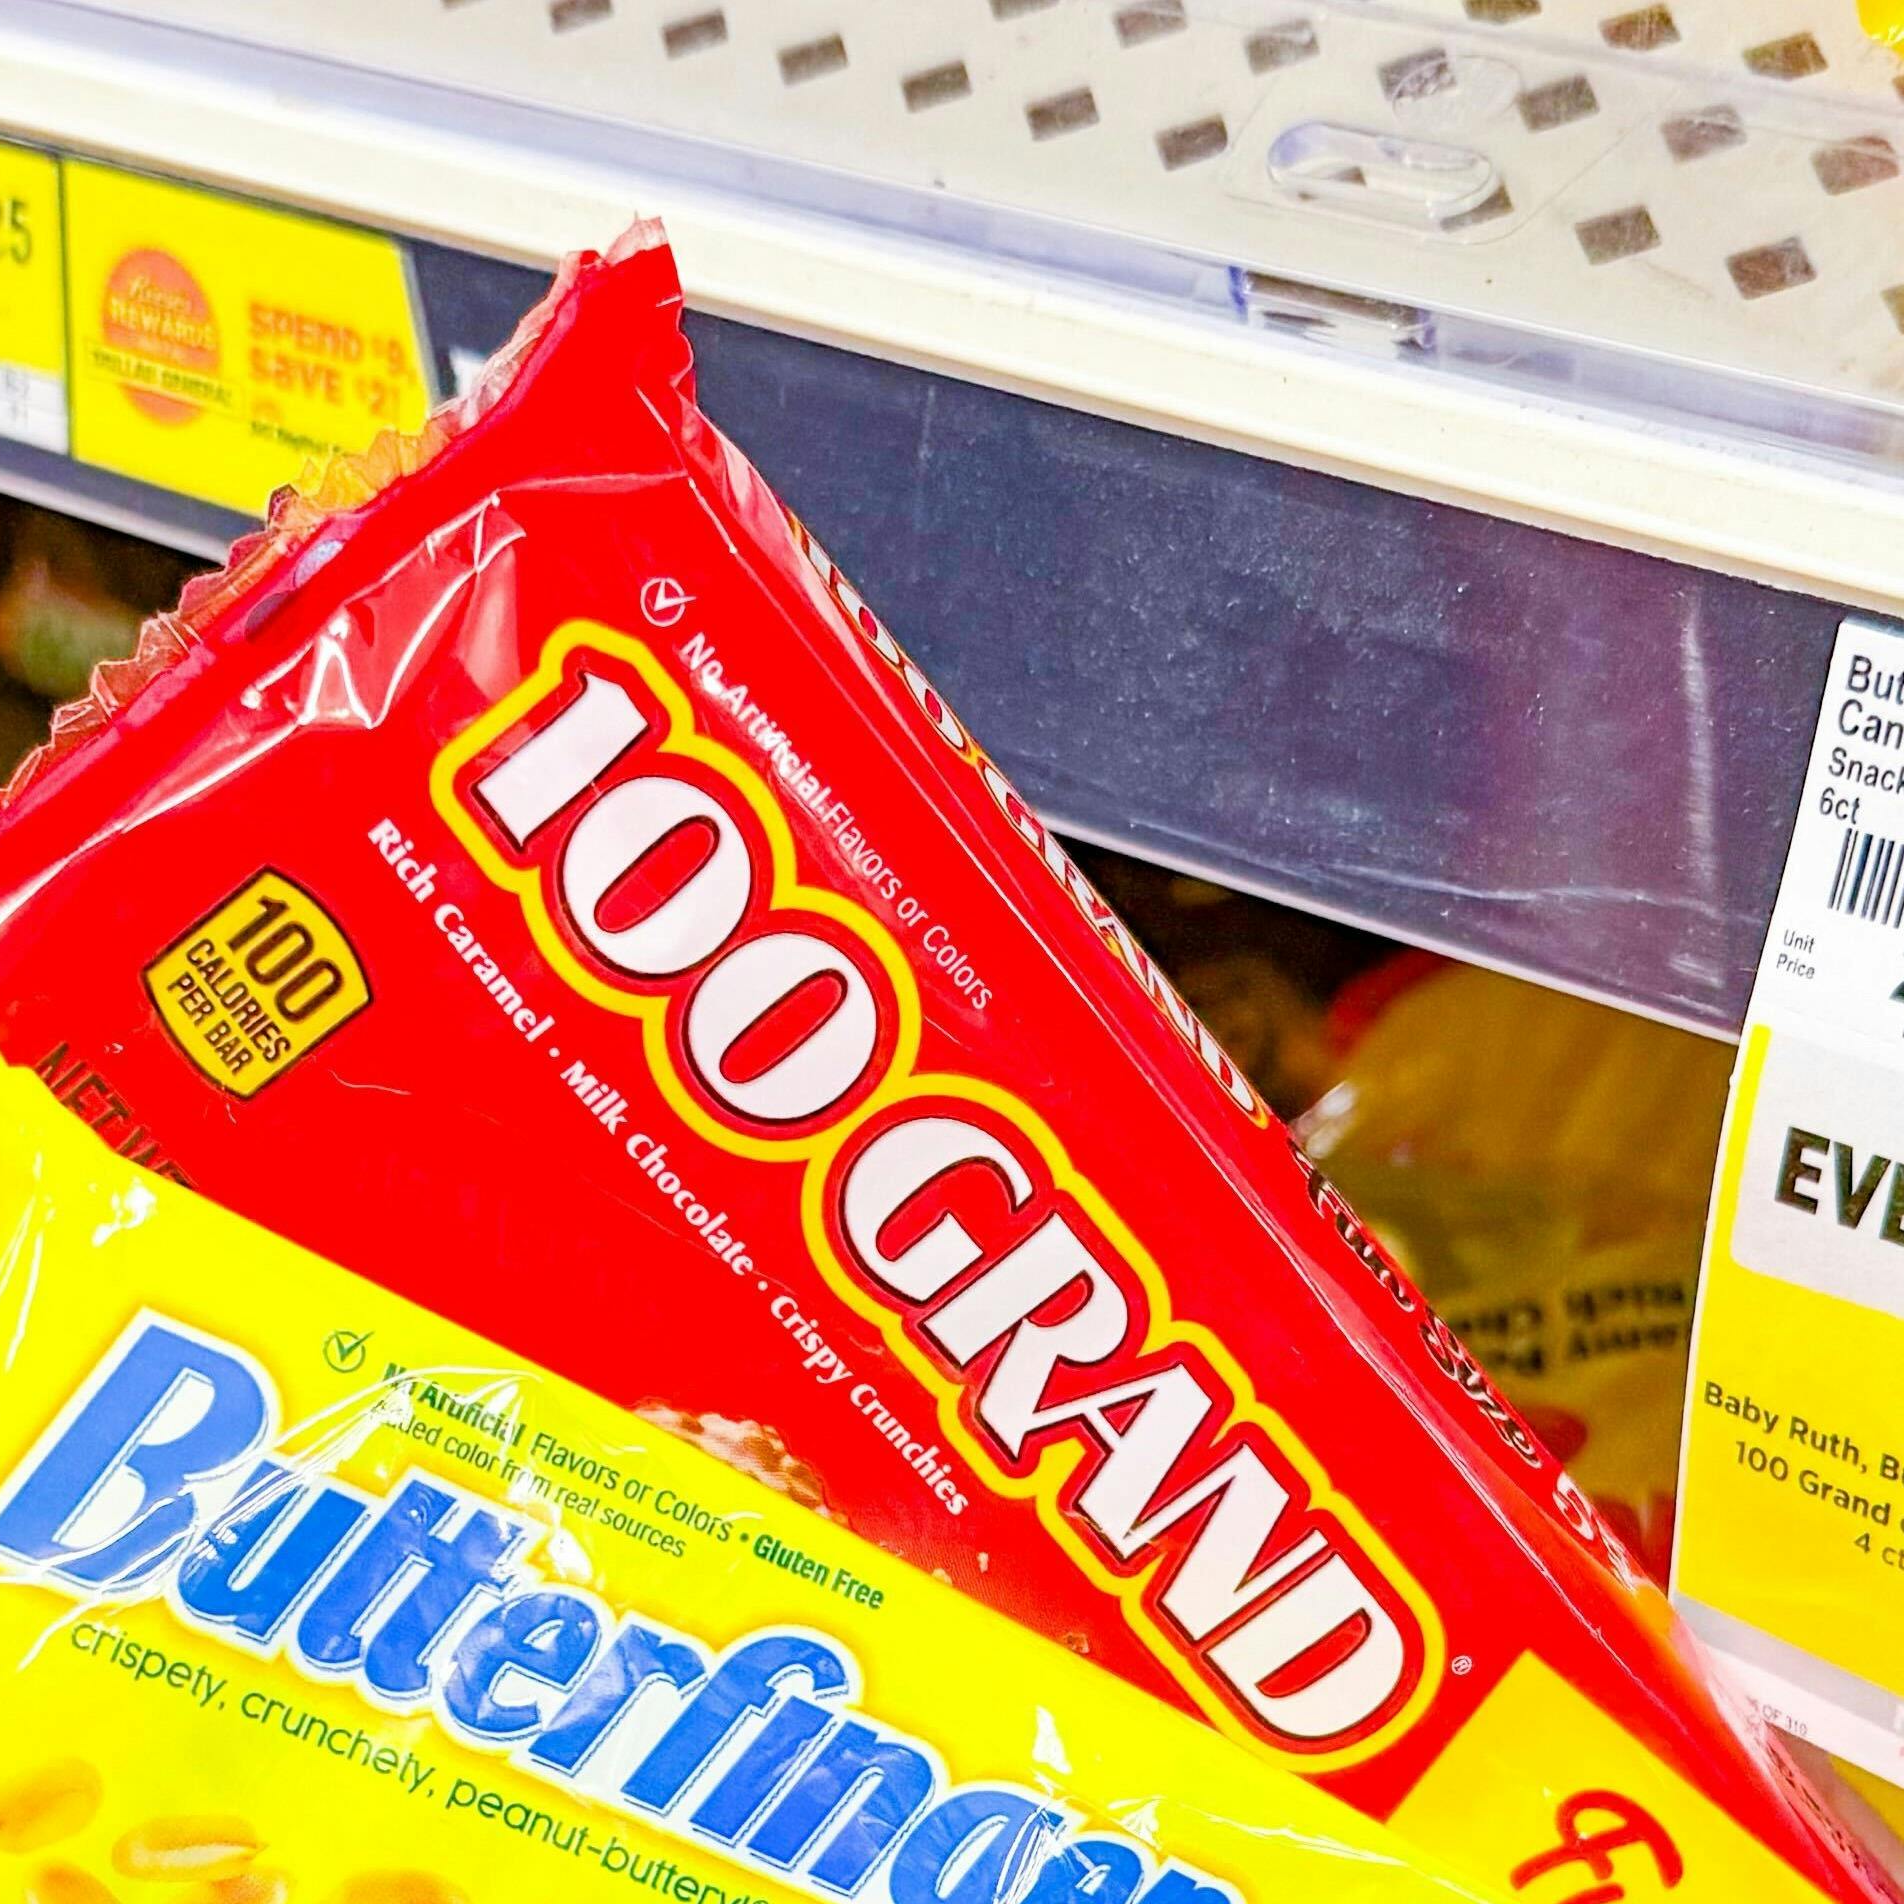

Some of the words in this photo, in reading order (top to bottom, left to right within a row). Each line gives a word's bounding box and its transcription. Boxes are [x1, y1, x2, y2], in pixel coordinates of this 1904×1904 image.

[249, 301, 364, 363] SPEND
[680, 632, 723, 693] No
[821, 802, 902, 902] Flavors
[897, 896, 929, 928] or
[923, 925, 992, 1011] Colors
[1819, 789, 1860, 824] 6ct
[226, 896, 344, 1026] 100
[984, 763, 1256, 1113] GRAND
[1776, 954, 1815, 979] Price
[1784, 929, 1815, 953] Unit
[167, 972, 216, 1023] PER
[202, 1019, 257, 1075] BAR
[186, 938, 292, 1063] CALORIES
[368, 818, 437, 904] Rich
[434, 902, 556, 1043] Caramel
[560, 1059, 626, 1136] Milk
[626, 1132, 755, 1278] Chocolate
[770, 1295, 855, 1386] Crispy
[850, 1384, 970, 1517] Crunchies
[477, 671, 877, 1121] 100
[838, 1115, 1405, 1739] GRAND
[1703, 1381, 1779, 1434] Baby
[1788, 1416, 1868, 1473] Ruth,
[1734, 1441, 1788, 1481] 100
[1798, 1469, 1891, 1526] Grand
[418, 1381, 527, 1447] Artificial
[529, 1431, 618, 1491] Flavors
[623, 1478, 652, 1504] or
[653, 1489, 734, 1543] Colors
[752, 1534, 829, 1585] Gluten
[831, 1568, 885, 1611] Free
[443, 1435, 503, 1473] color
[500, 1460, 551, 1500] from
[554, 1485, 600, 1524] real
[599, 1509, 687, 1558] sources
[1853, 1532, 1871, 1554] 4
[70, 1619, 227, 1711] crispety,
[241, 1686, 436, 1800] crunchety,
